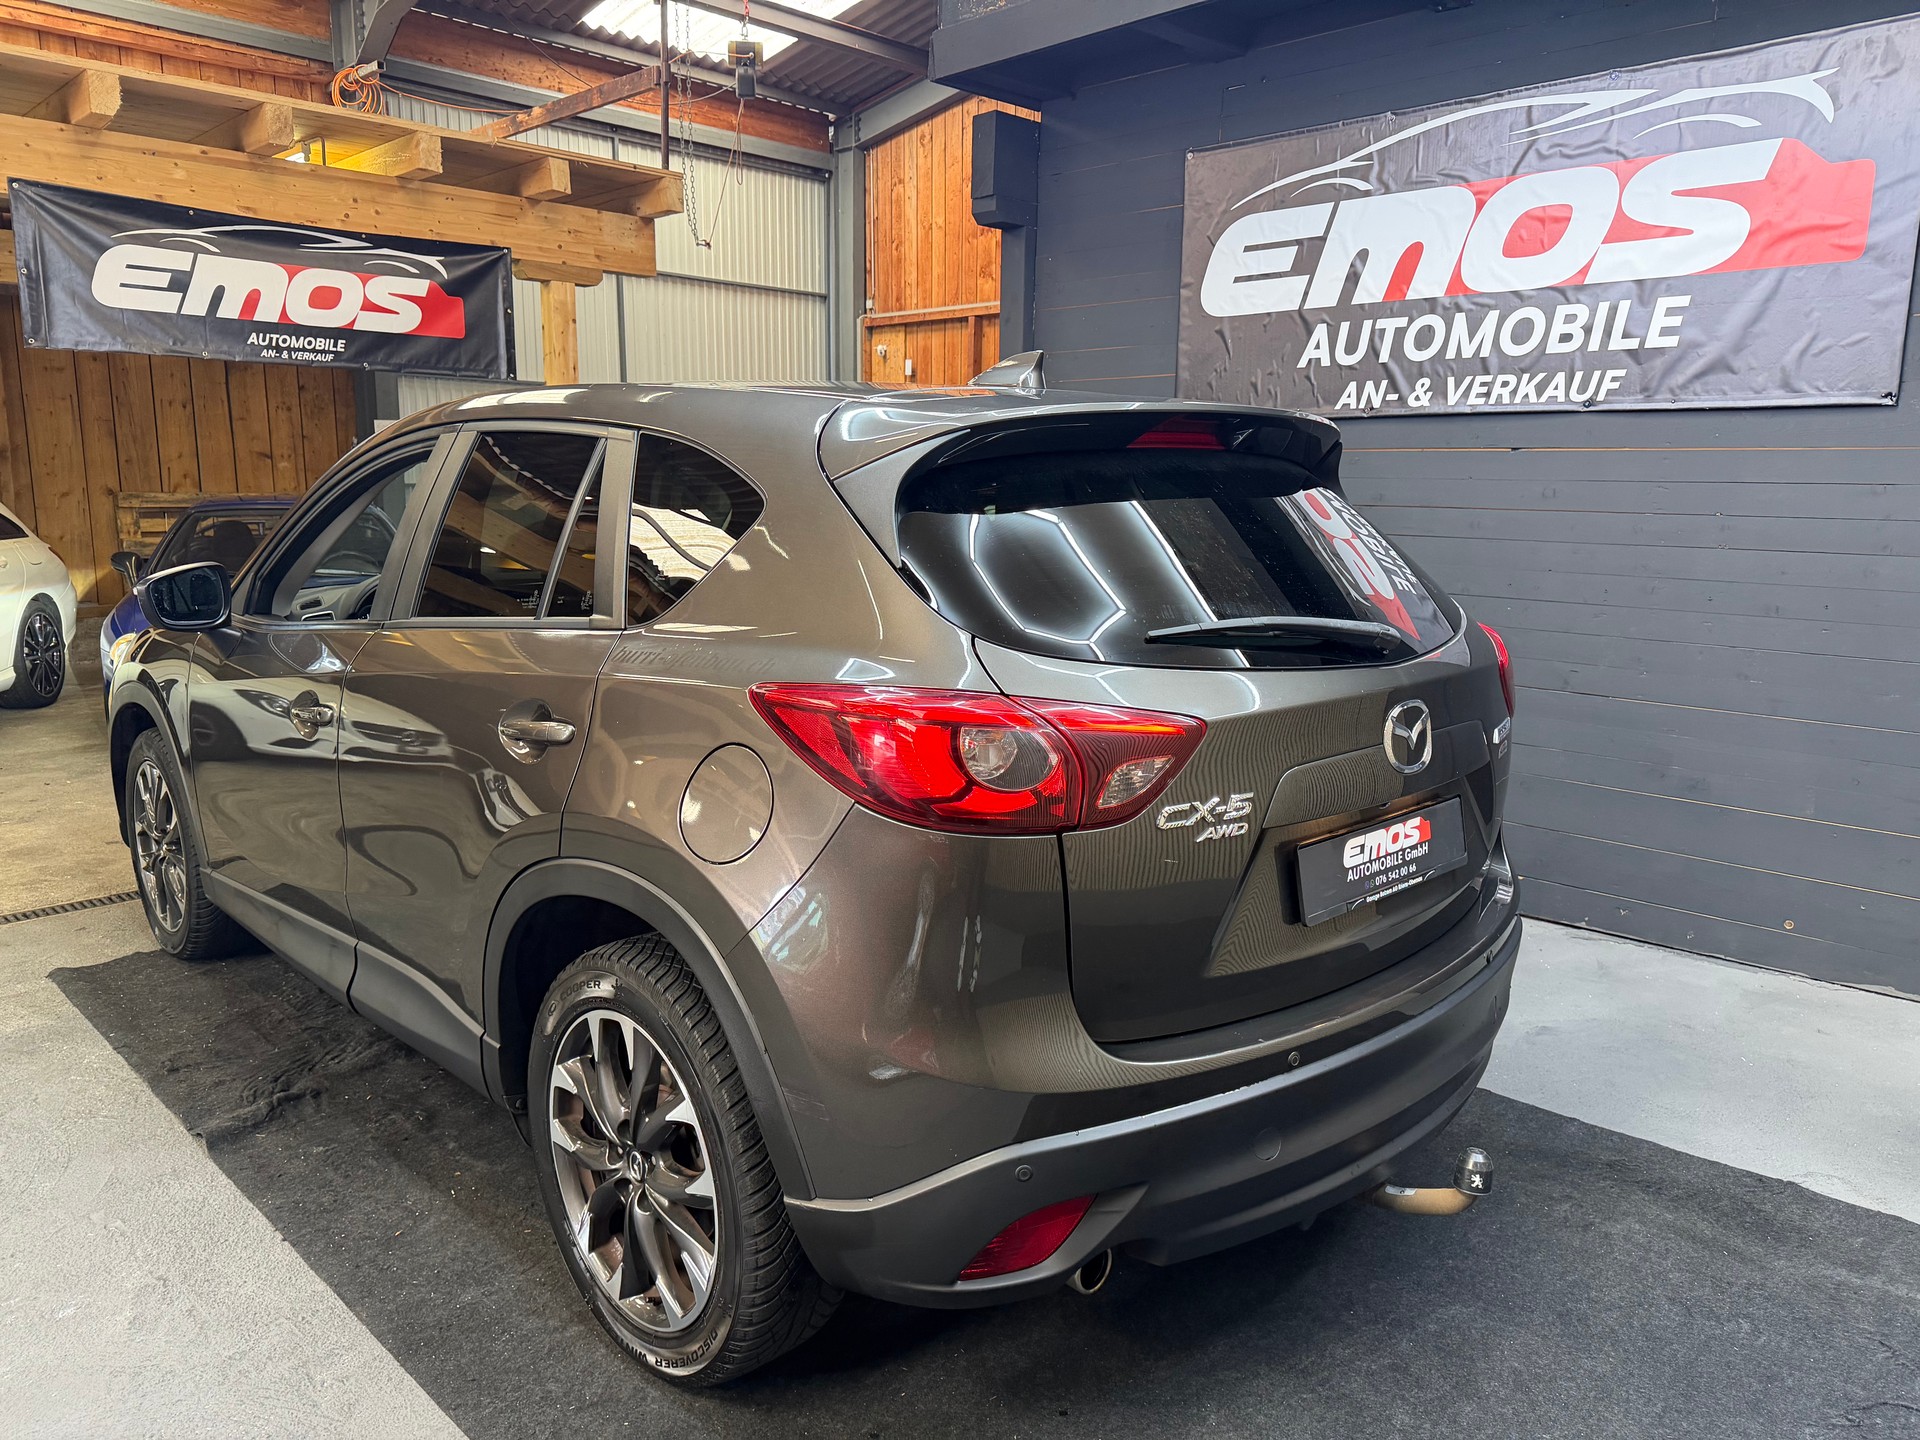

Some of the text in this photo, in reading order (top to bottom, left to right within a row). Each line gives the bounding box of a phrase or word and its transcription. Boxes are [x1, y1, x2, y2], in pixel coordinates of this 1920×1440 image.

[247, 332, 346, 351] AUTOMOBILE
[1297, 295, 1691, 368] AUTOMOBILE
[261, 348, 335, 362] AN- & VERKAUF
[1334, 369, 1627, 410] AN- & VERKAUF
[1156, 792, 1254, 830] CX-5
[1196, 822, 1249, 842] AWD
[1347, 842, 1429, 882] AUTOMOBILE GmbH
[1375, 863, 1416, 885] 076 542 00 66
[560, 979, 601, 1001] COOPER
[620, 1328, 718, 1368] DISCOVERER WINT
